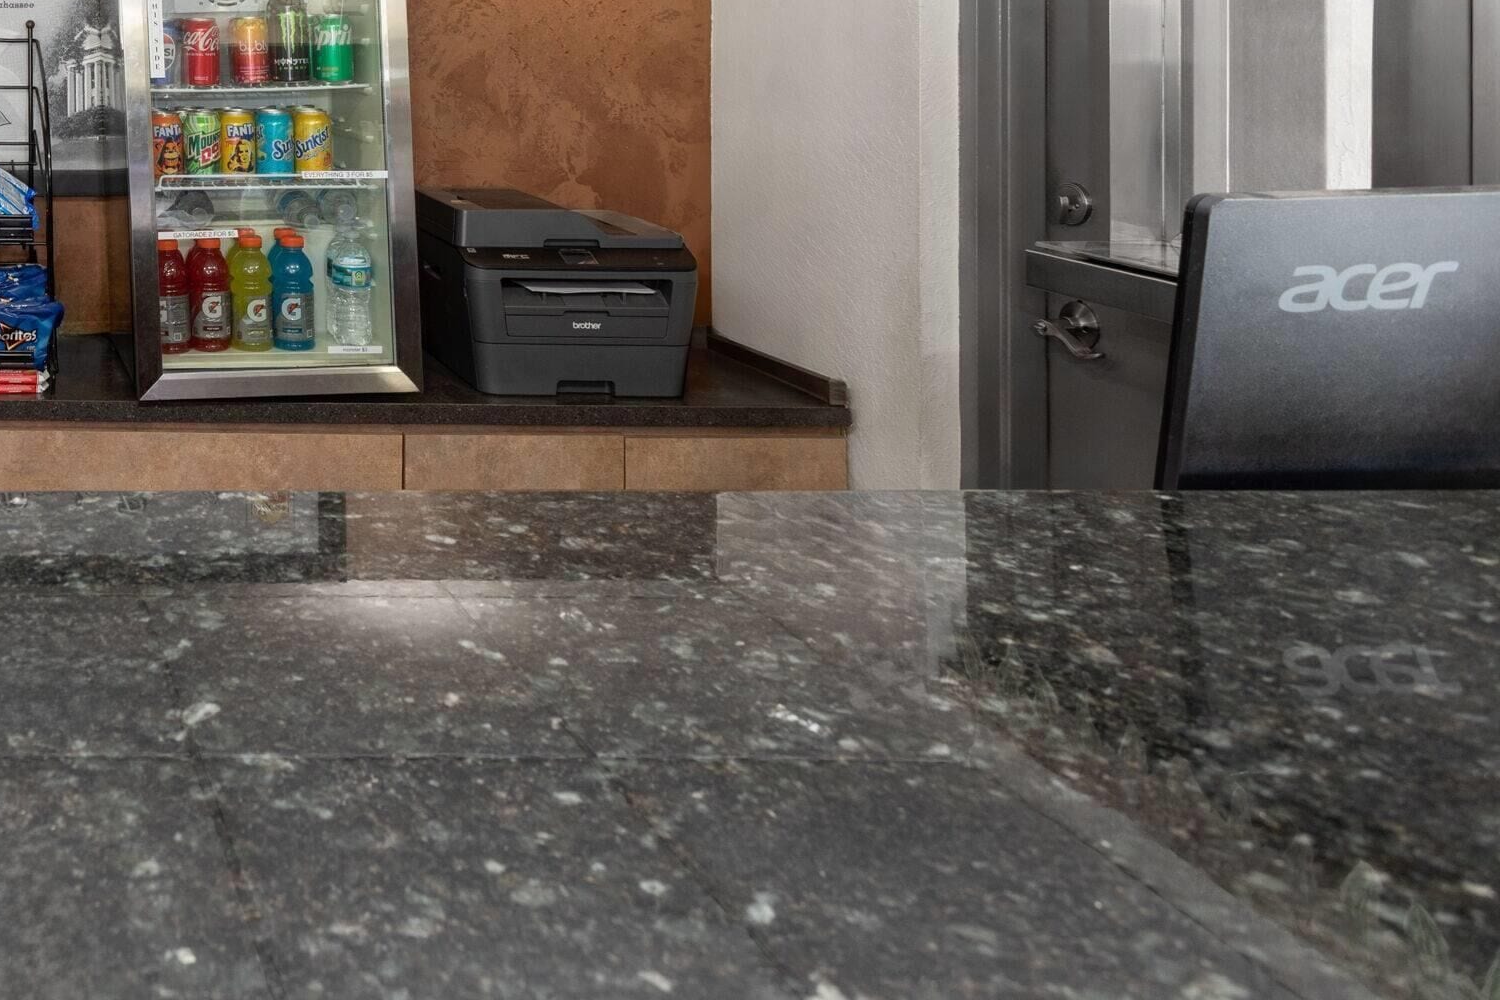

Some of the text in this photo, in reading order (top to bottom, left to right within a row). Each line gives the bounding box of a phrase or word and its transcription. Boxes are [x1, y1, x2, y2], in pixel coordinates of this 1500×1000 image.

[153, 38, 161, 70] SIDE
[295, 126, 330, 159] Sunkist
[1277, 260, 1459, 313] acer
[572, 321, 602, 330] brother
